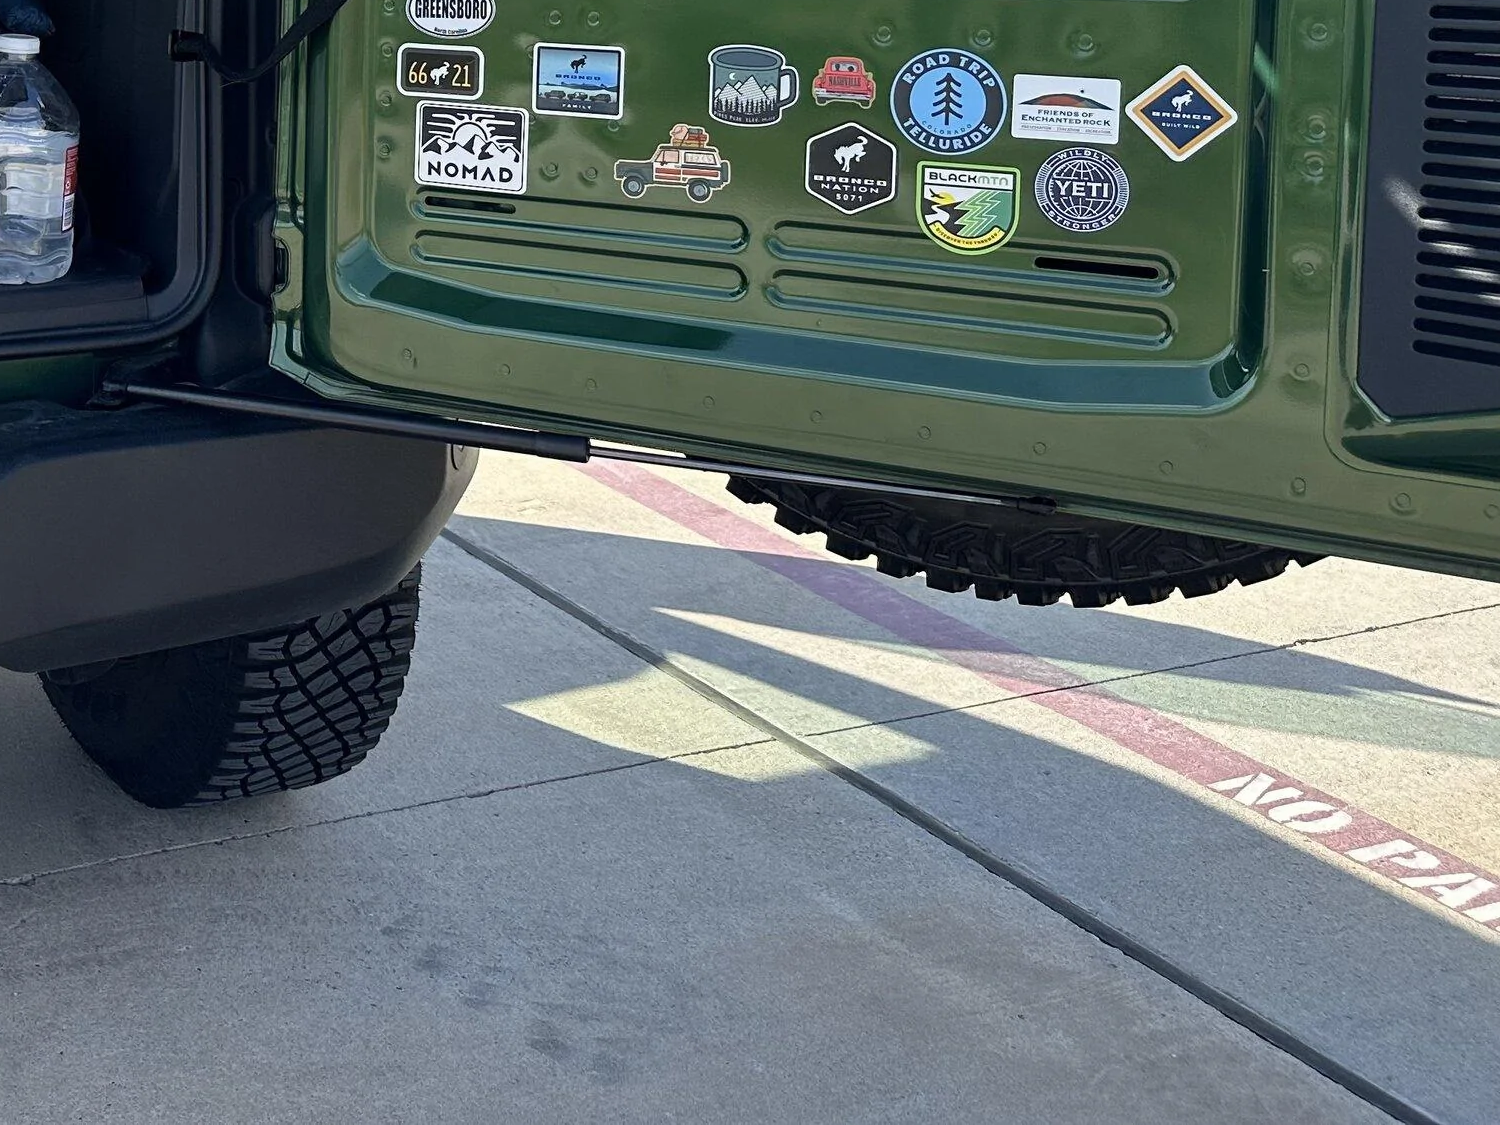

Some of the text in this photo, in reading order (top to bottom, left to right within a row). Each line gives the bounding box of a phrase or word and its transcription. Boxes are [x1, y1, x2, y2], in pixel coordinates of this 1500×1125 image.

[408, 61, 471, 87] 66 21
[555, 73, 601, 81] BRONCO
[902, 54, 996, 87] ROAD TRIP
[828, 76, 861, 86] NASHVILLE
[1037, 109, 1079, 117] FRIENDS
[1151, 111, 1212, 121] BRONCO
[1021, 114, 1111, 127] ENCHANTED ROCK
[903, 118, 992, 150] TELLURIDE
[922, 120, 972, 135] COLORADO
[1057, 149, 1108, 162] WILDLY
[427, 160, 513, 183] NOMAD
[813, 175, 887, 187] BRONCO
[821, 183, 879, 194] NATION
[1054, 179, 1109, 198] YETI
[836, 193, 863, 202] 5071
[1048, 210, 1116, 230] STRONGER
[1206, 772, 1352, 834] NO
